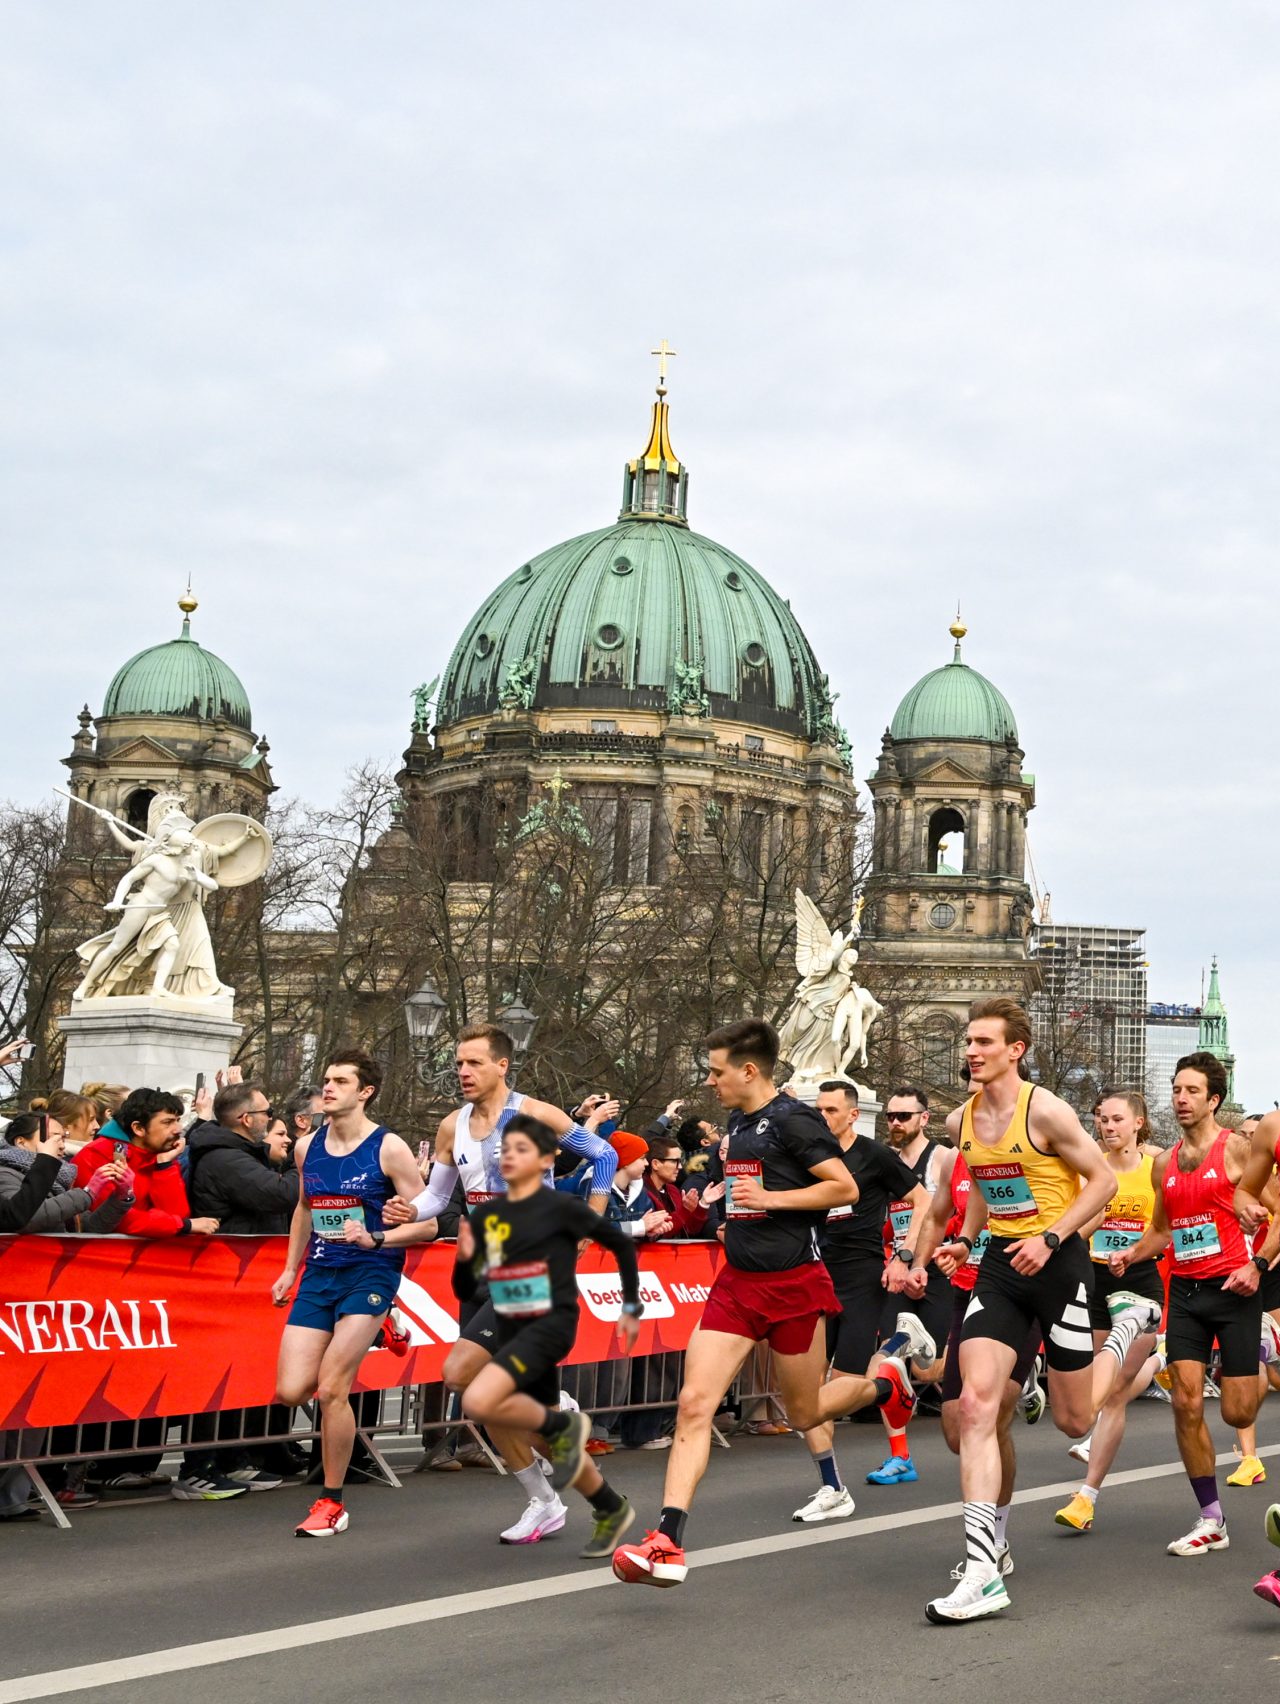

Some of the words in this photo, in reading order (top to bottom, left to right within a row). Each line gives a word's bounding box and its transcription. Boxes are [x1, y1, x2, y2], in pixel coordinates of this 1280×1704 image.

[983, 1165, 1020, 1177] GENERALI
[988, 1186, 1015, 1199] 366
[322, 1199, 358, 1207] GENERALI
[994, 1205, 1020, 1213] GARMIN
[1180, 1212, 1212, 1225] GENERALI
[1105, 1236, 1129, 1247] 752
[1181, 1231, 1205, 1246] 844
[1182, 1249, 1206, 1259] GARMIN
[503, 1283, 532, 1298] 963
